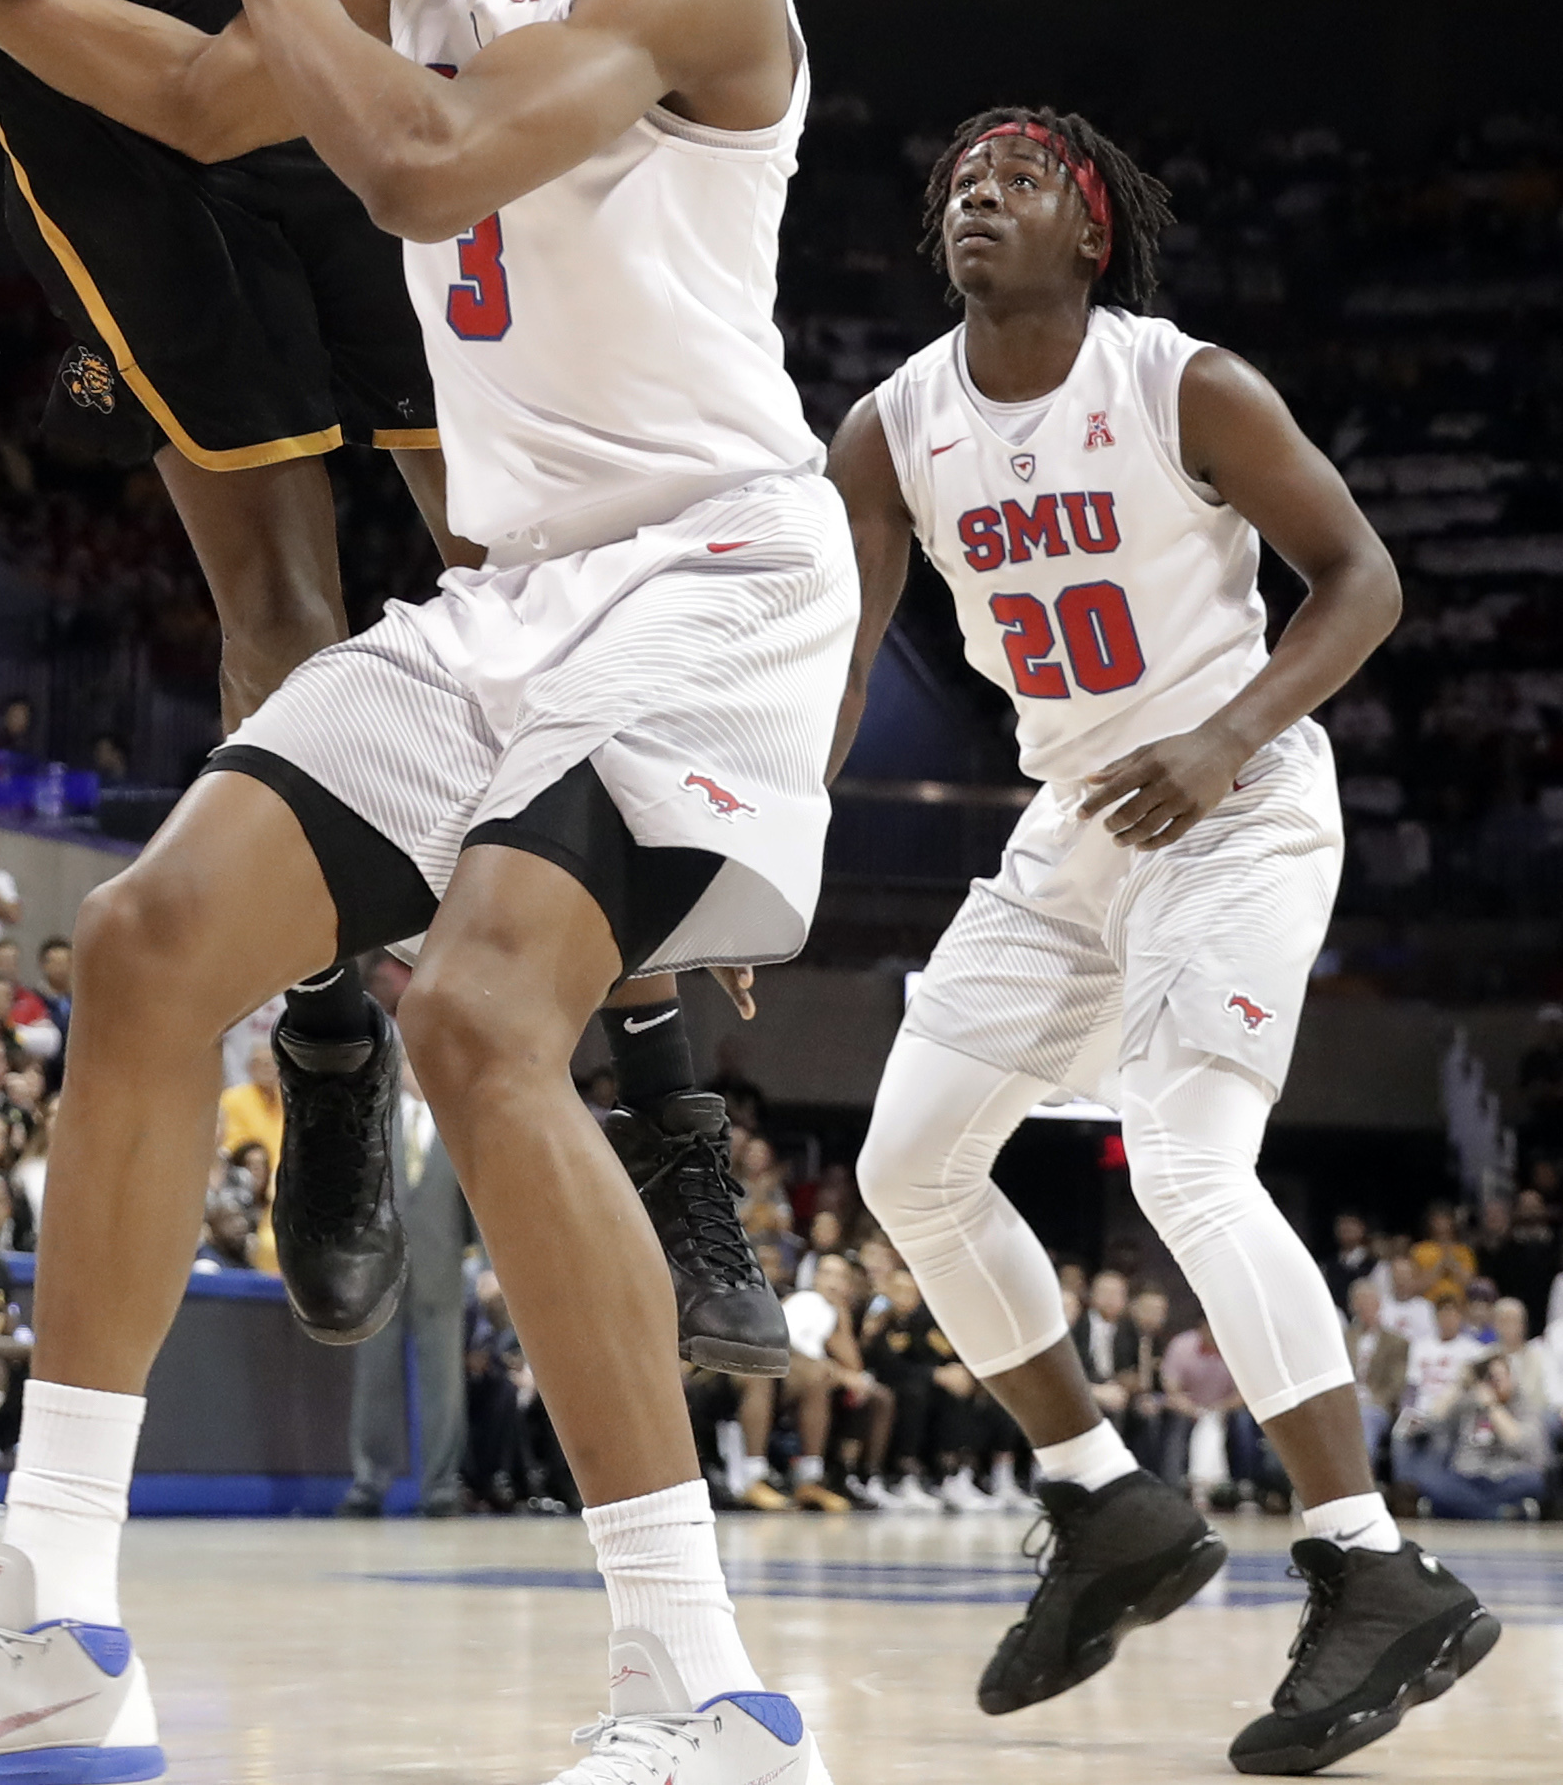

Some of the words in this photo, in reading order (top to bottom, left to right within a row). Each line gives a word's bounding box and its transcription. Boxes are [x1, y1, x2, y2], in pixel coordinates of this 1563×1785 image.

[446, 211, 512, 341] 3
[958, 491, 1122, 573] SMU
[988, 579, 1146, 699] 20
